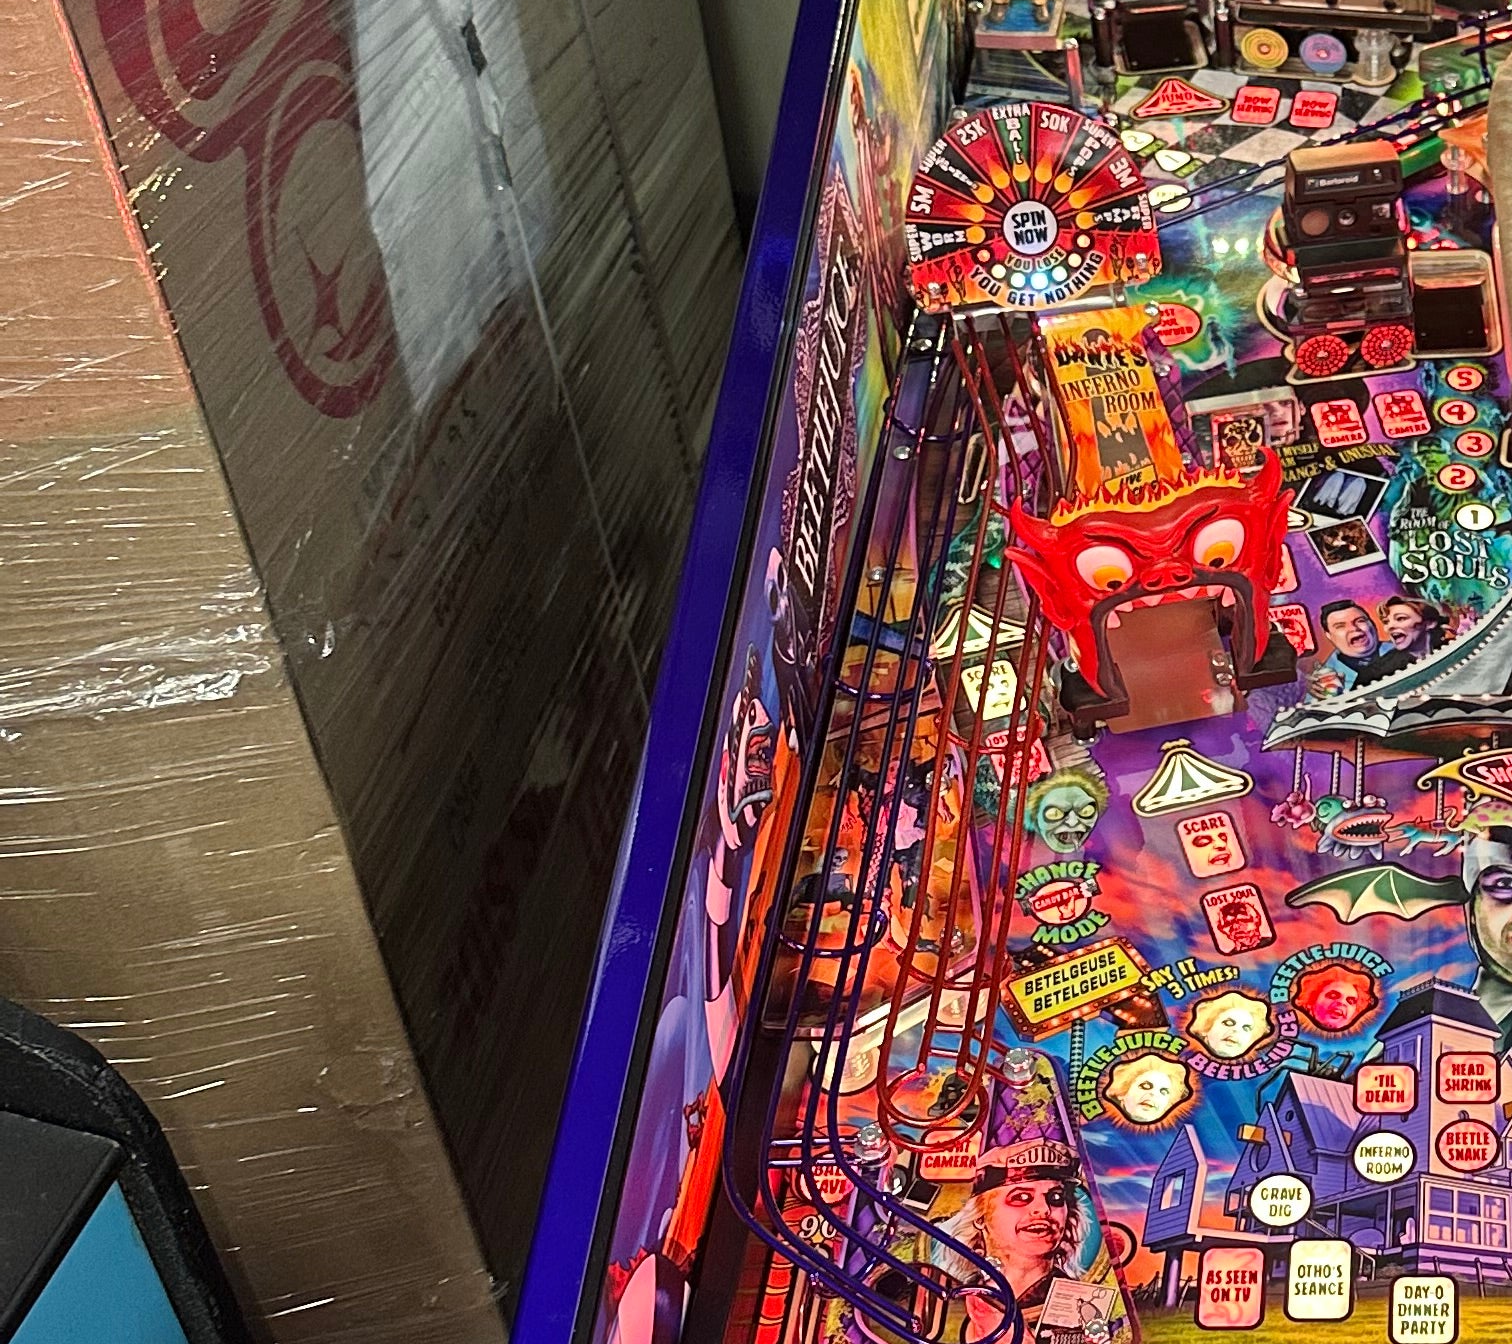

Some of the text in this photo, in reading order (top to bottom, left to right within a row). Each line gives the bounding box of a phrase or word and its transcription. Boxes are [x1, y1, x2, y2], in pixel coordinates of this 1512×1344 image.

[992, 103, 1031, 121] EXTRA
[956, 118, 987, 146] 25K
[1039, 111, 1072, 134] 50K
[1108, 157, 1138, 189] 3M
[910, 184, 935, 214] 5M
[1011, 210, 1047, 229] SPIN
[919, 229, 966, 252] WORM
[1014, 227, 1049, 246] NOW
[1005, 247, 1067, 271] YOU LOSE
[969, 252, 1104, 307] YOU GET NOTHING
[1061, 368, 1141, 402] INFERNO
[1457, 371, 1473, 388] 5
[1105, 391, 1157, 414] ROOM
[1446, 404, 1467, 421] 4
[796, 252, 862, 596] BEETLEJUICE
[1388, 423, 1429, 437] CAMERA
[1323, 433, 1363, 445] CAMERA
[1466, 436, 1482, 453] 3
[1338, 443, 1401, 463] UNUSUAL
[1450, 468, 1467, 485] 2
[1407, 529, 1492, 559] LOST
[1401, 552, 1511, 589] SOULS
[1183, 816, 1228, 836] SCARE
[1015, 861, 1101, 899] CHANGE
[1205, 888, 1255, 907] LOST SOUL
[1032, 910, 1111, 944] MODE
[1024, 950, 1117, 996] BETELGEUSE
[1141, 957, 1197, 993] SAY IT
[1185, 965, 1240, 992] TIMES!
[1269, 942, 1394, 1005] BEETLEJUICE
[1033, 965, 1128, 1013] BETELGEUSE
[1076, 1032, 1189, 1121] BEETLEJUICE
[1452, 1062, 1486, 1078] HEAD
[1445, 1076, 1492, 1093] SHRINK
[1365, 1088, 1405, 1104] DEATH
[1446, 1131, 1491, 1148] BEETLE
[924, 1155, 978, 1169] CAMERA
[1016, 1147, 1066, 1166] GUIDE
[1359, 1145, 1411, 1161] INFERNO
[1447, 1146, 1489, 1163] SNAKE
[1366, 1159, 1404, 1177] ROOM
[1260, 1186, 1303, 1203] GRAVE
[1268, 1202, 1293, 1218] DIG
[1205, 1267, 1258, 1287] AS SEEN
[1296, 1264, 1344, 1281] OTHO'S
[1209, 1285, 1252, 1304] ON TV
[1294, 1280, 1345, 1298] SEANCE
[1403, 1284, 1445, 1302] DAY-O
[1397, 1301, 1451, 1319] DINNER
[1400, 1319, 1448, 1337] PARTY
